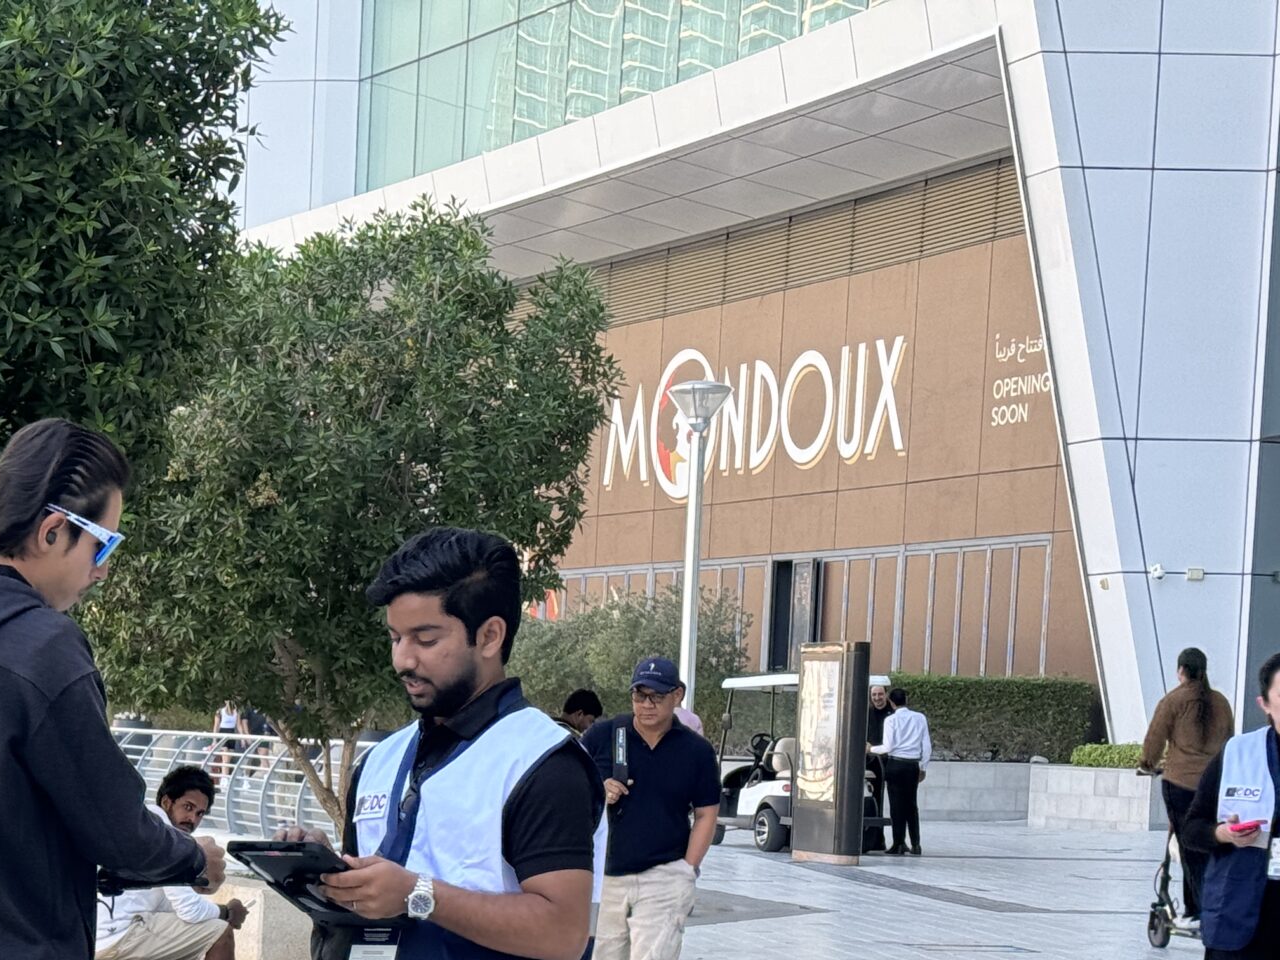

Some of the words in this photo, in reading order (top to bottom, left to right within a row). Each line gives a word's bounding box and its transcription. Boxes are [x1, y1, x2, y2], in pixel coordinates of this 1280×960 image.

[992, 371, 1051, 399] OPENING
[603, 335, 907, 500] MONDOUX
[991, 402, 1028, 427] SOON
